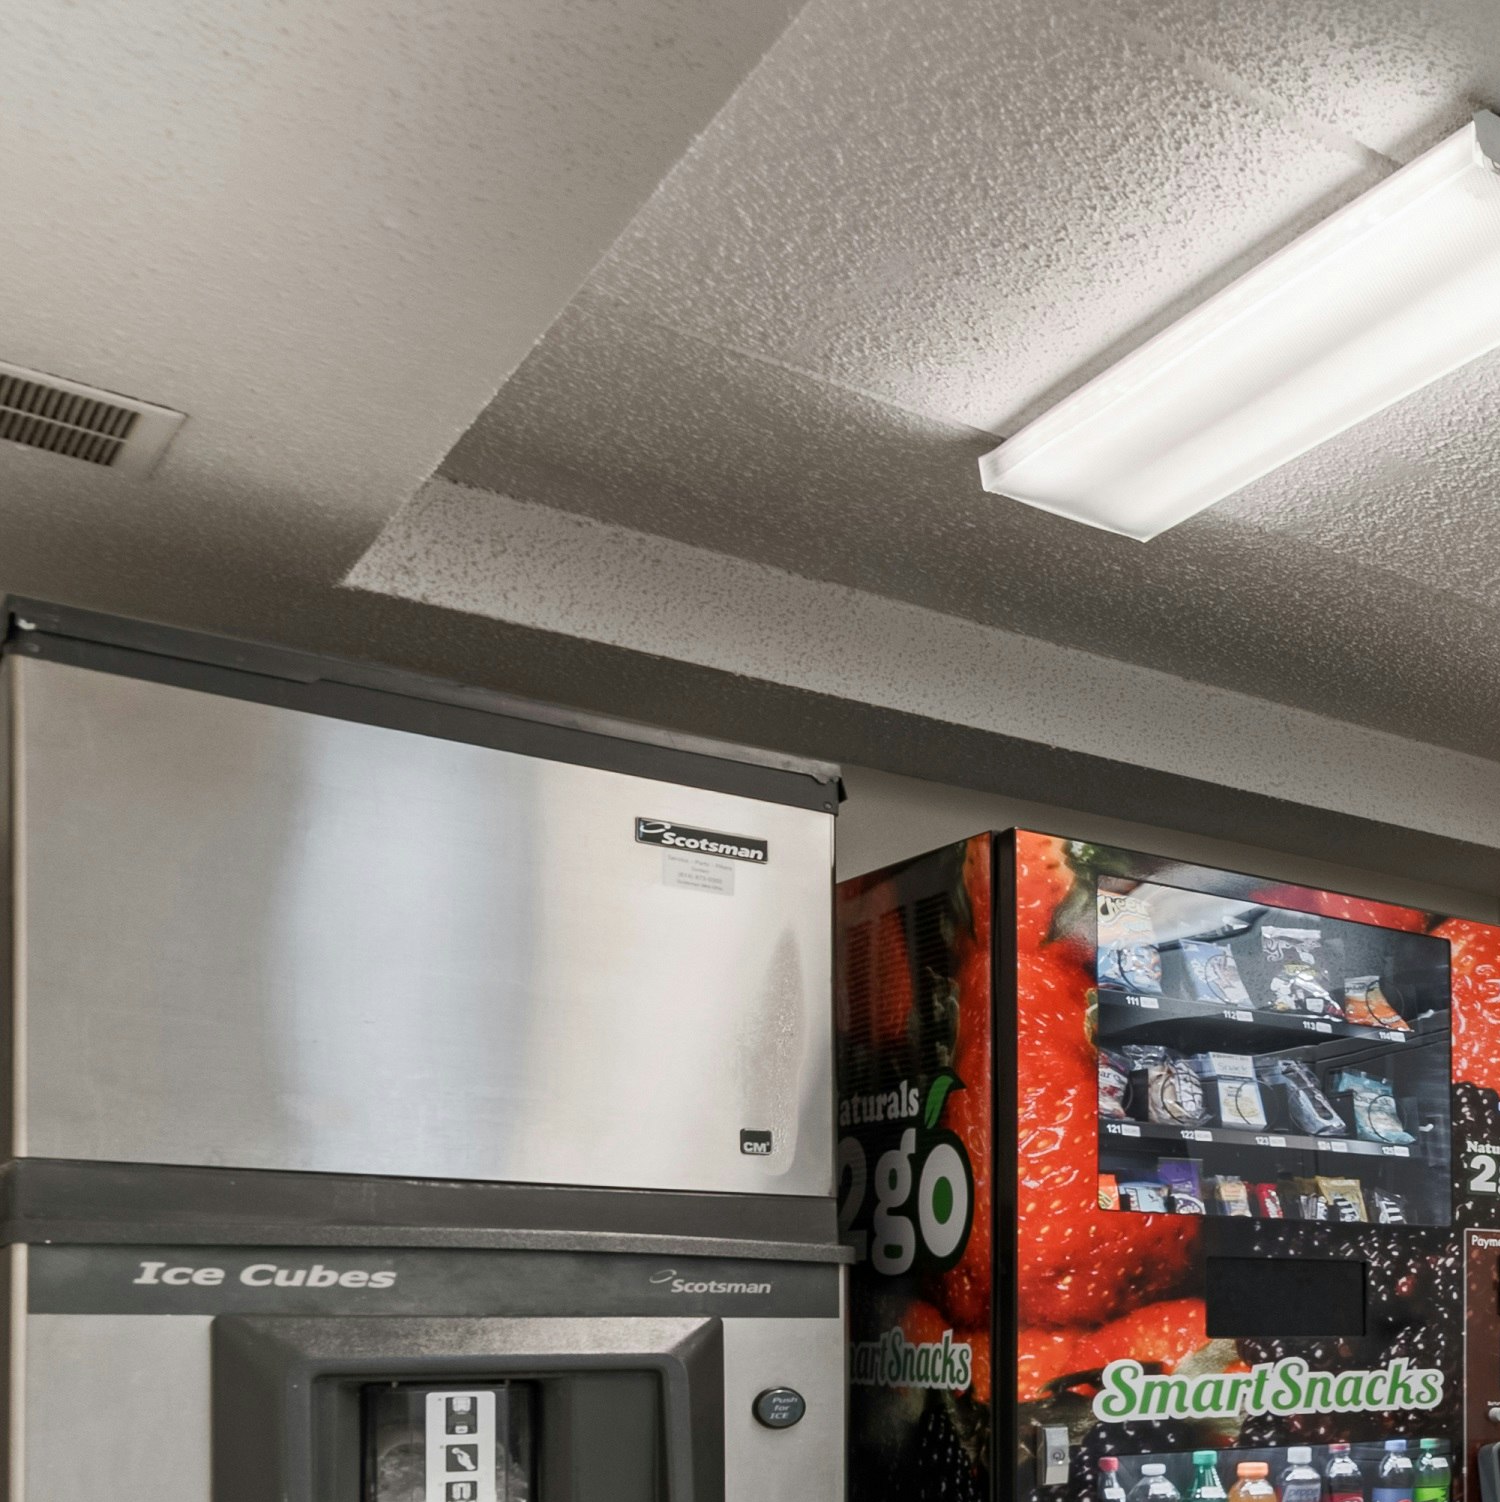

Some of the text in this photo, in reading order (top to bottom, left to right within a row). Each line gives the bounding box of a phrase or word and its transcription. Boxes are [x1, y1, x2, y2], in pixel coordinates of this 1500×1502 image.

[661, 831, 764, 860] Scotsman
[839, 1080, 920, 1127] aturals
[1107, 1124, 1121, 1134] 121
[1181, 1130, 1195, 1139] 122
[838, 1127, 968, 1276] 2go
[133, 1261, 397, 1288] Ice Cubes
[671, 1278, 772, 1294] Scotsman
[851, 1329, 971, 1388] artSnacks
[772, 1396, 798, 1404] Push
[1098, 1360, 1441, 1419] SmartSnacks
